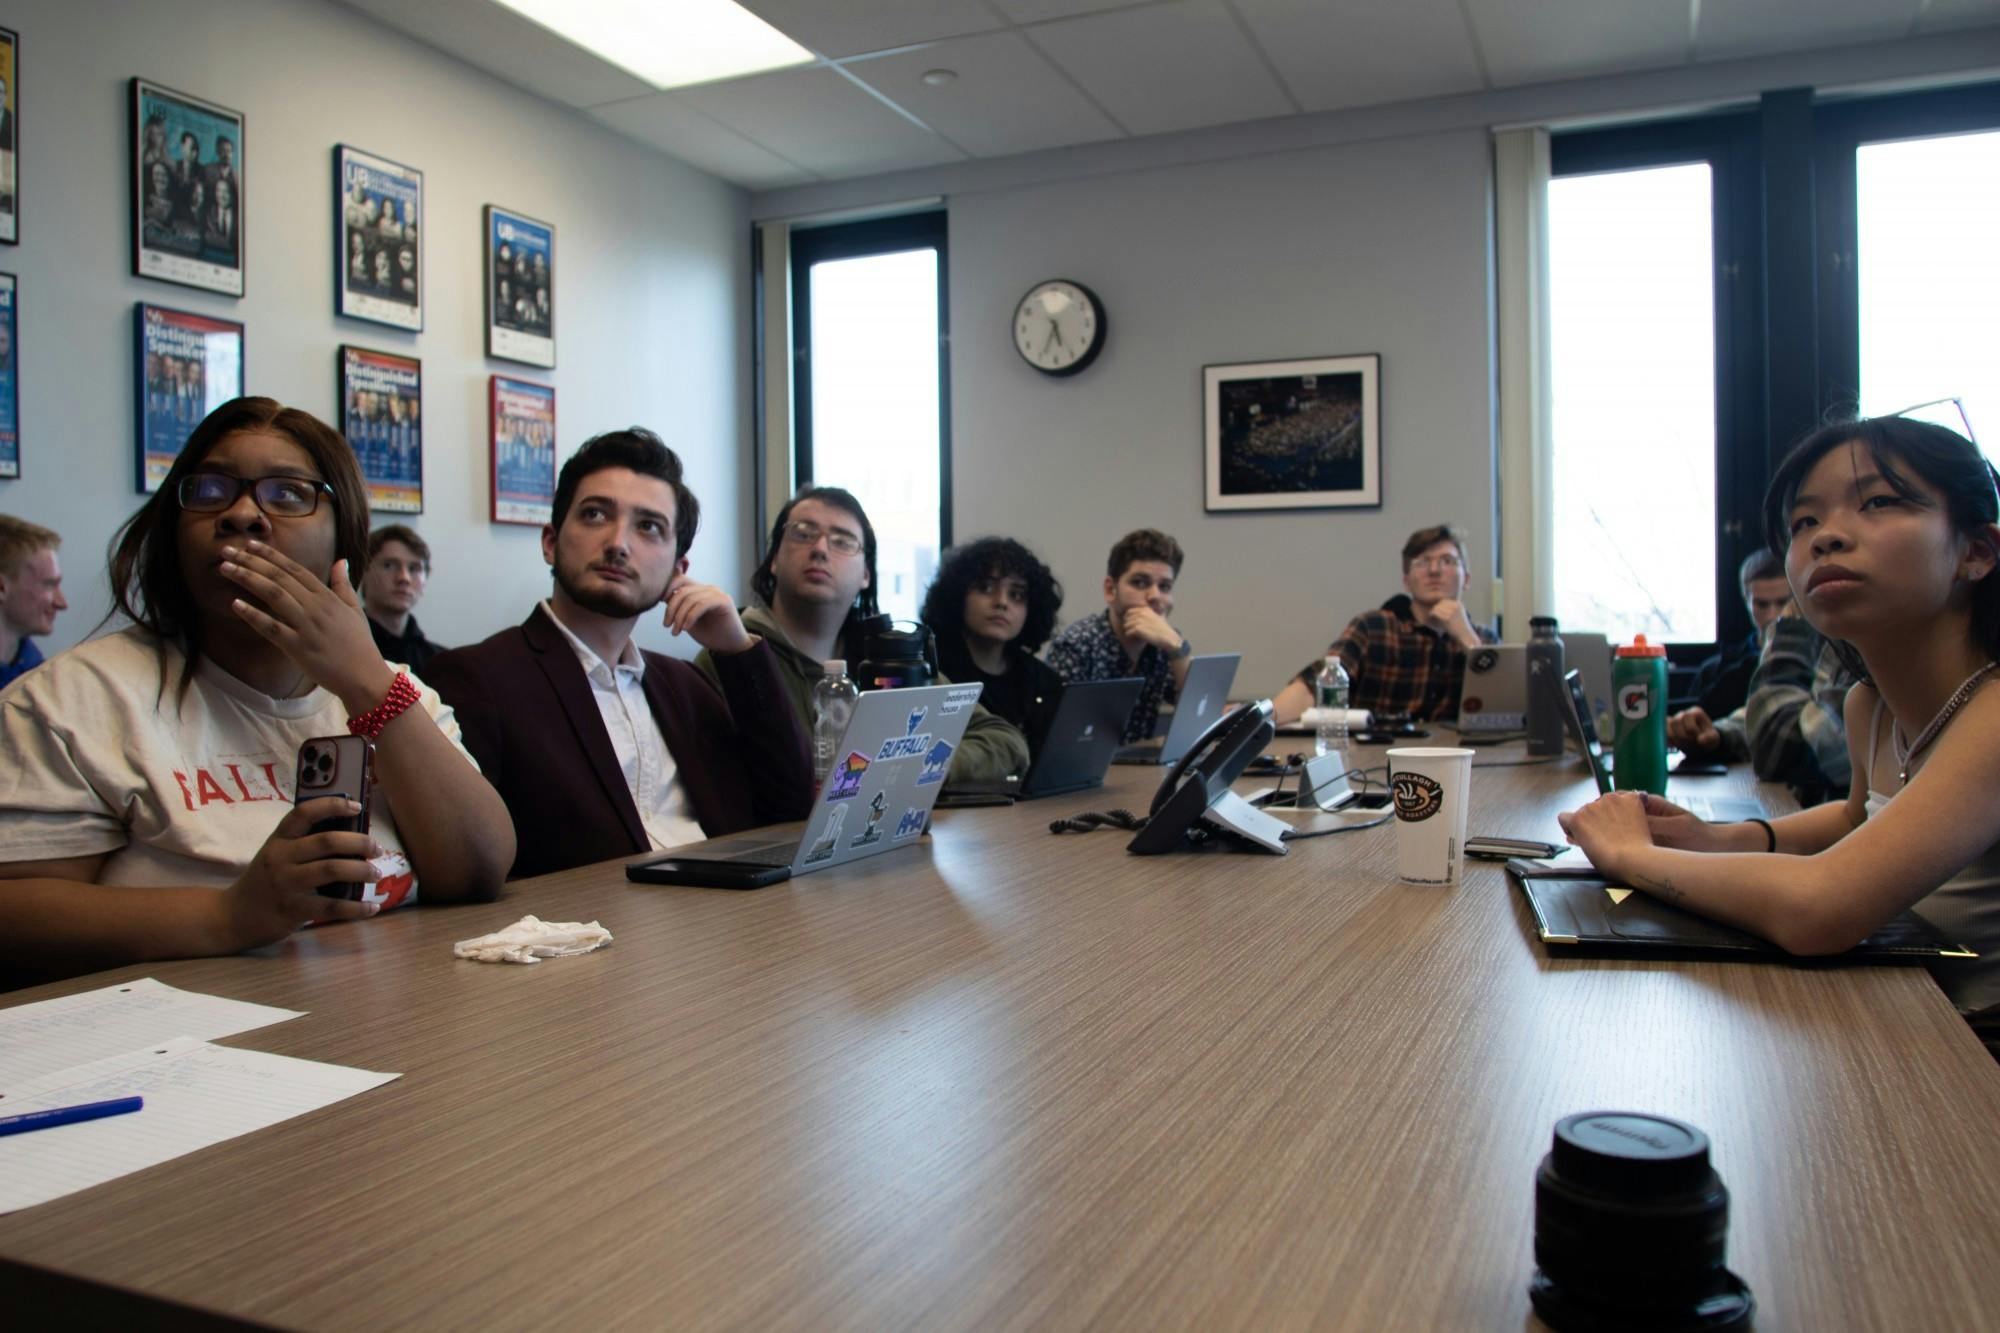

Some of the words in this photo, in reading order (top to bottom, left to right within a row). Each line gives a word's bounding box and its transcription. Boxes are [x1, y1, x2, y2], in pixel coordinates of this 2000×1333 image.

[346, 163, 369, 188] UB
[497, 222, 513, 241] UB
[146, 323, 206, 345] Distingu
[148, 337, 207, 361] Speaker
[1618, 684, 1648, 719] G
[877, 735, 930, 760] BUFFALO
